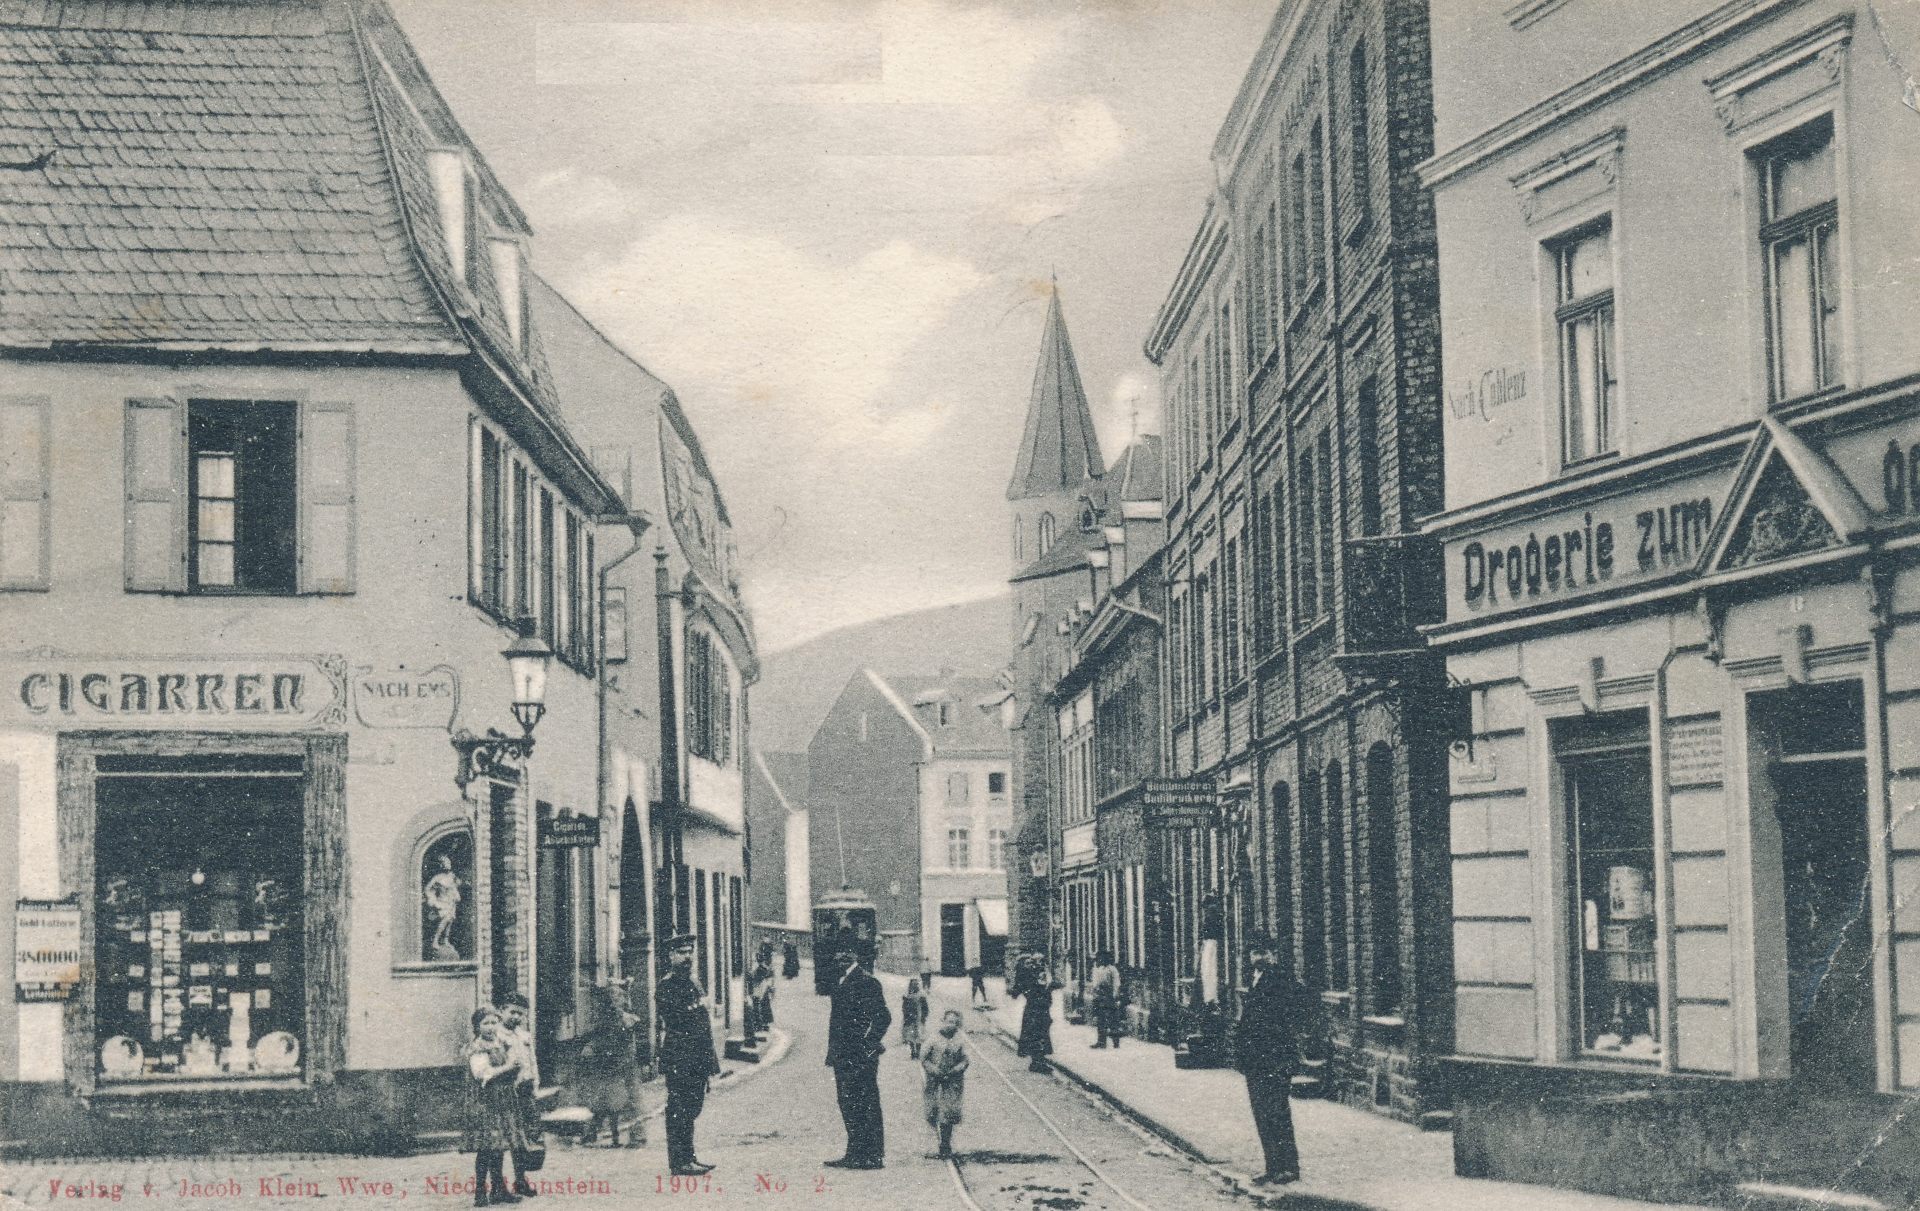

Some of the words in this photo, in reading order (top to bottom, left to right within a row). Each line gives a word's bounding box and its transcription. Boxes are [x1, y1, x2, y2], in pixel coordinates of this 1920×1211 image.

[1463, 511, 1614, 611] Drogerie
[1636, 497, 1711, 573] zum
[20, 672, 305, 715] CIGARREN
[363, 682, 409, 698] NACH
[417, 682, 451, 698] EMS
